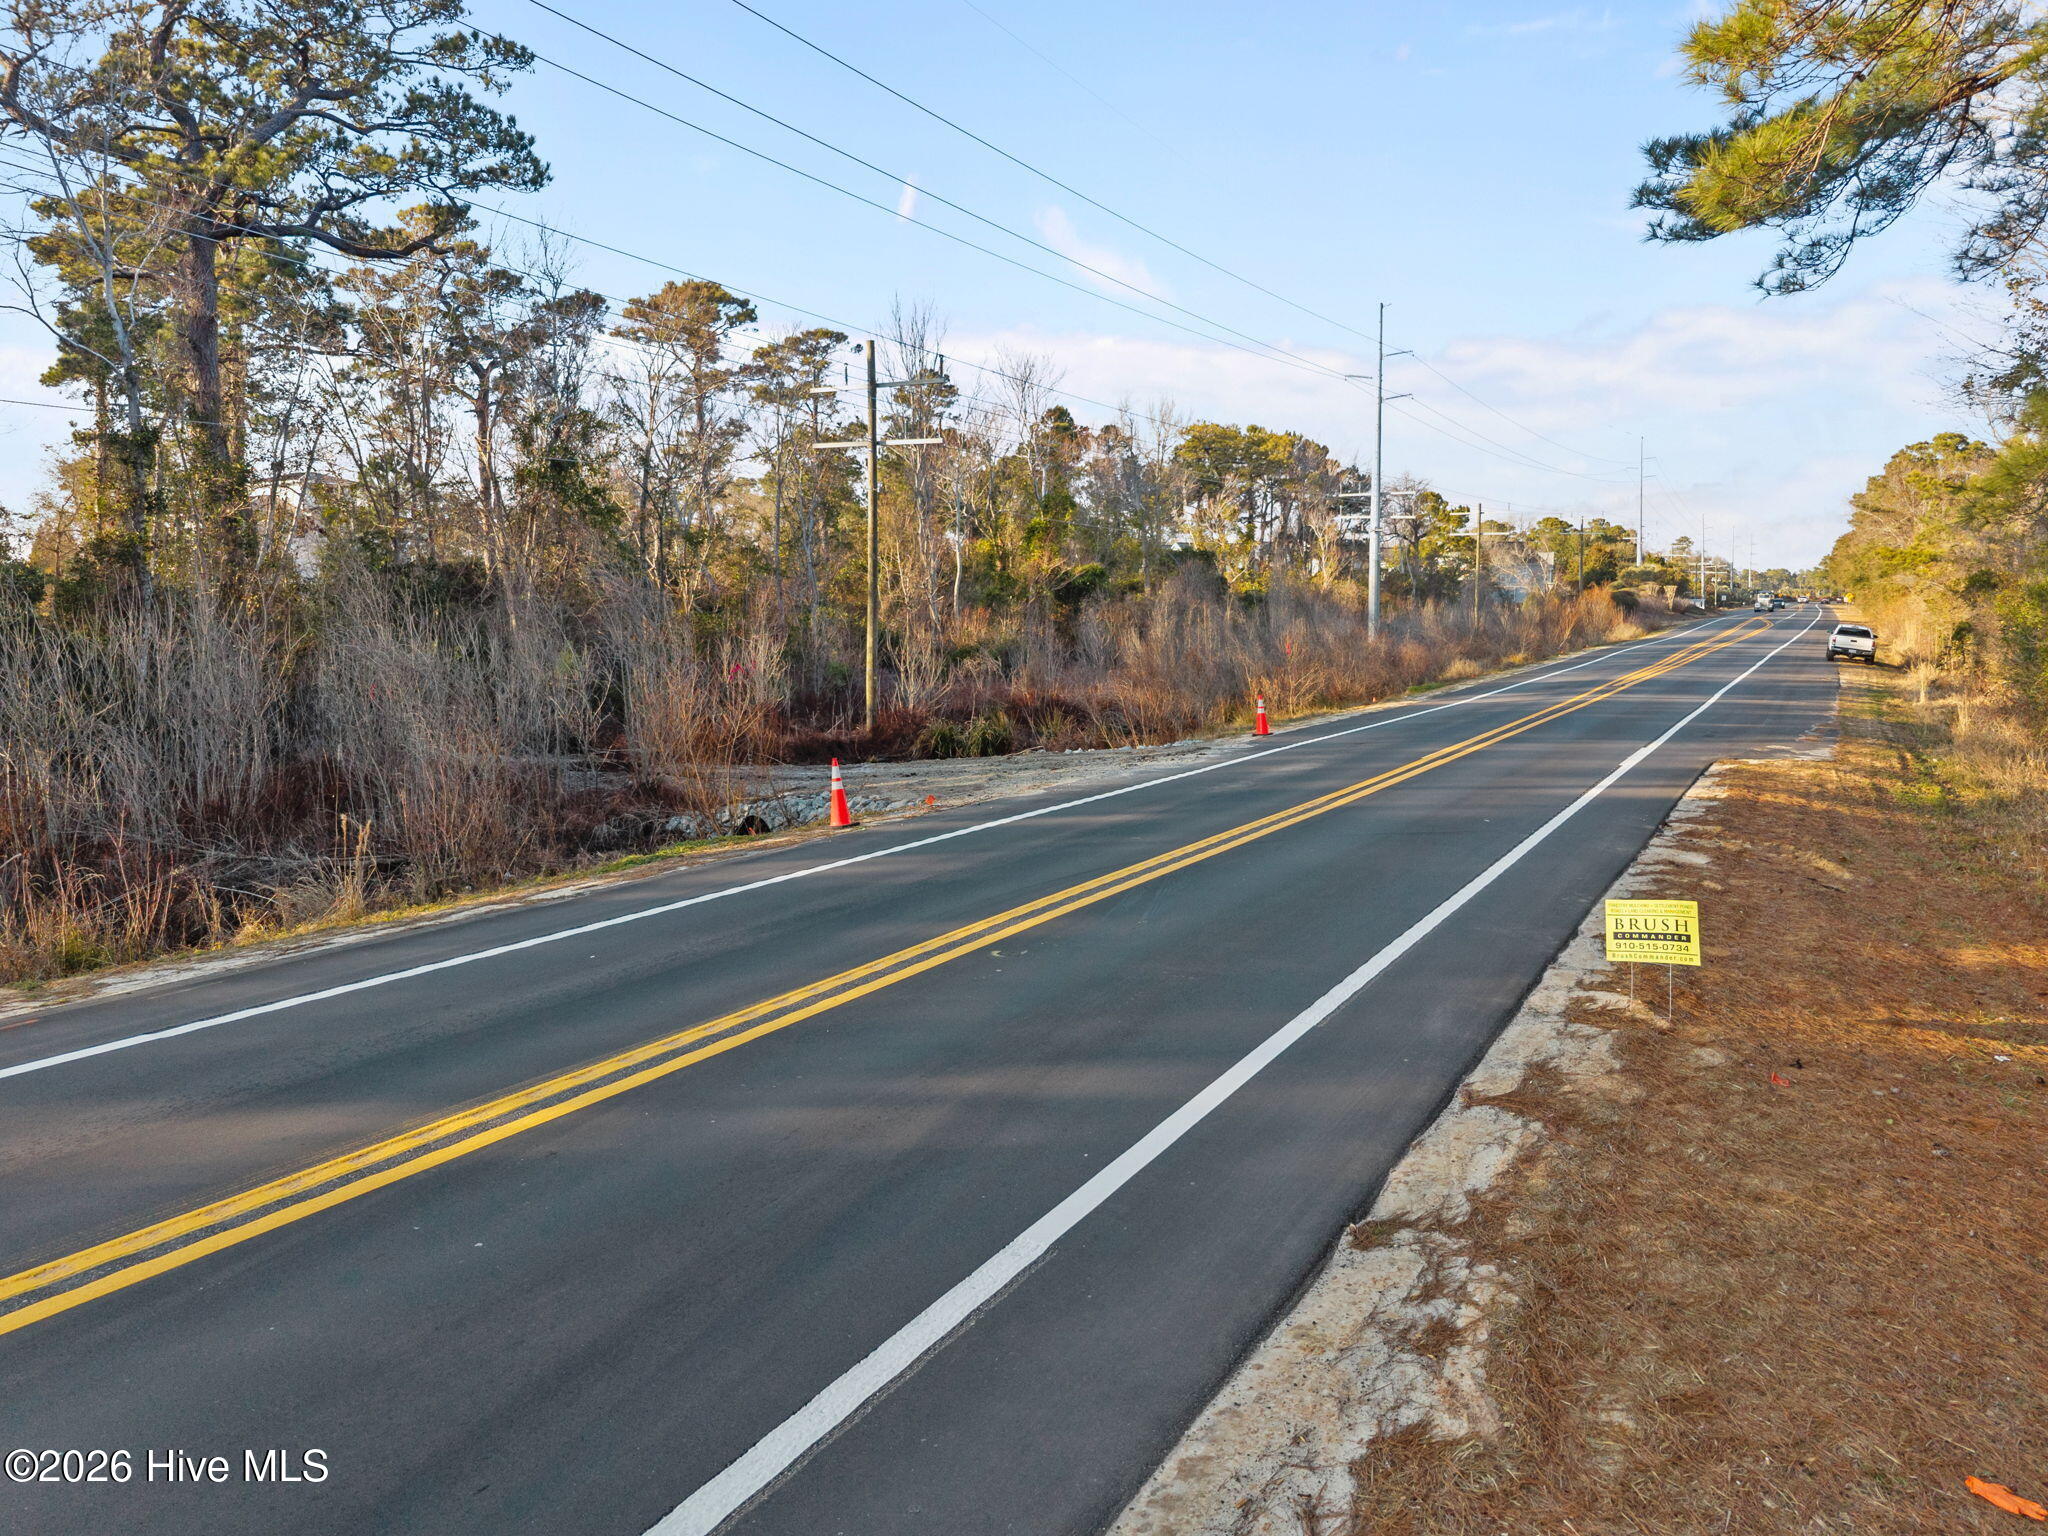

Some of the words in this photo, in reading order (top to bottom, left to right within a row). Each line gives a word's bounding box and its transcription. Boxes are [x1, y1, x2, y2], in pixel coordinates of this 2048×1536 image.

[1615, 918, 1688, 932] BRUSH
[1617, 933, 1687, 941] COMMANDER
[1615, 942, 1689, 952] 910-515-0734
[1612, 953, 1694, 962] BrushCommander.com
